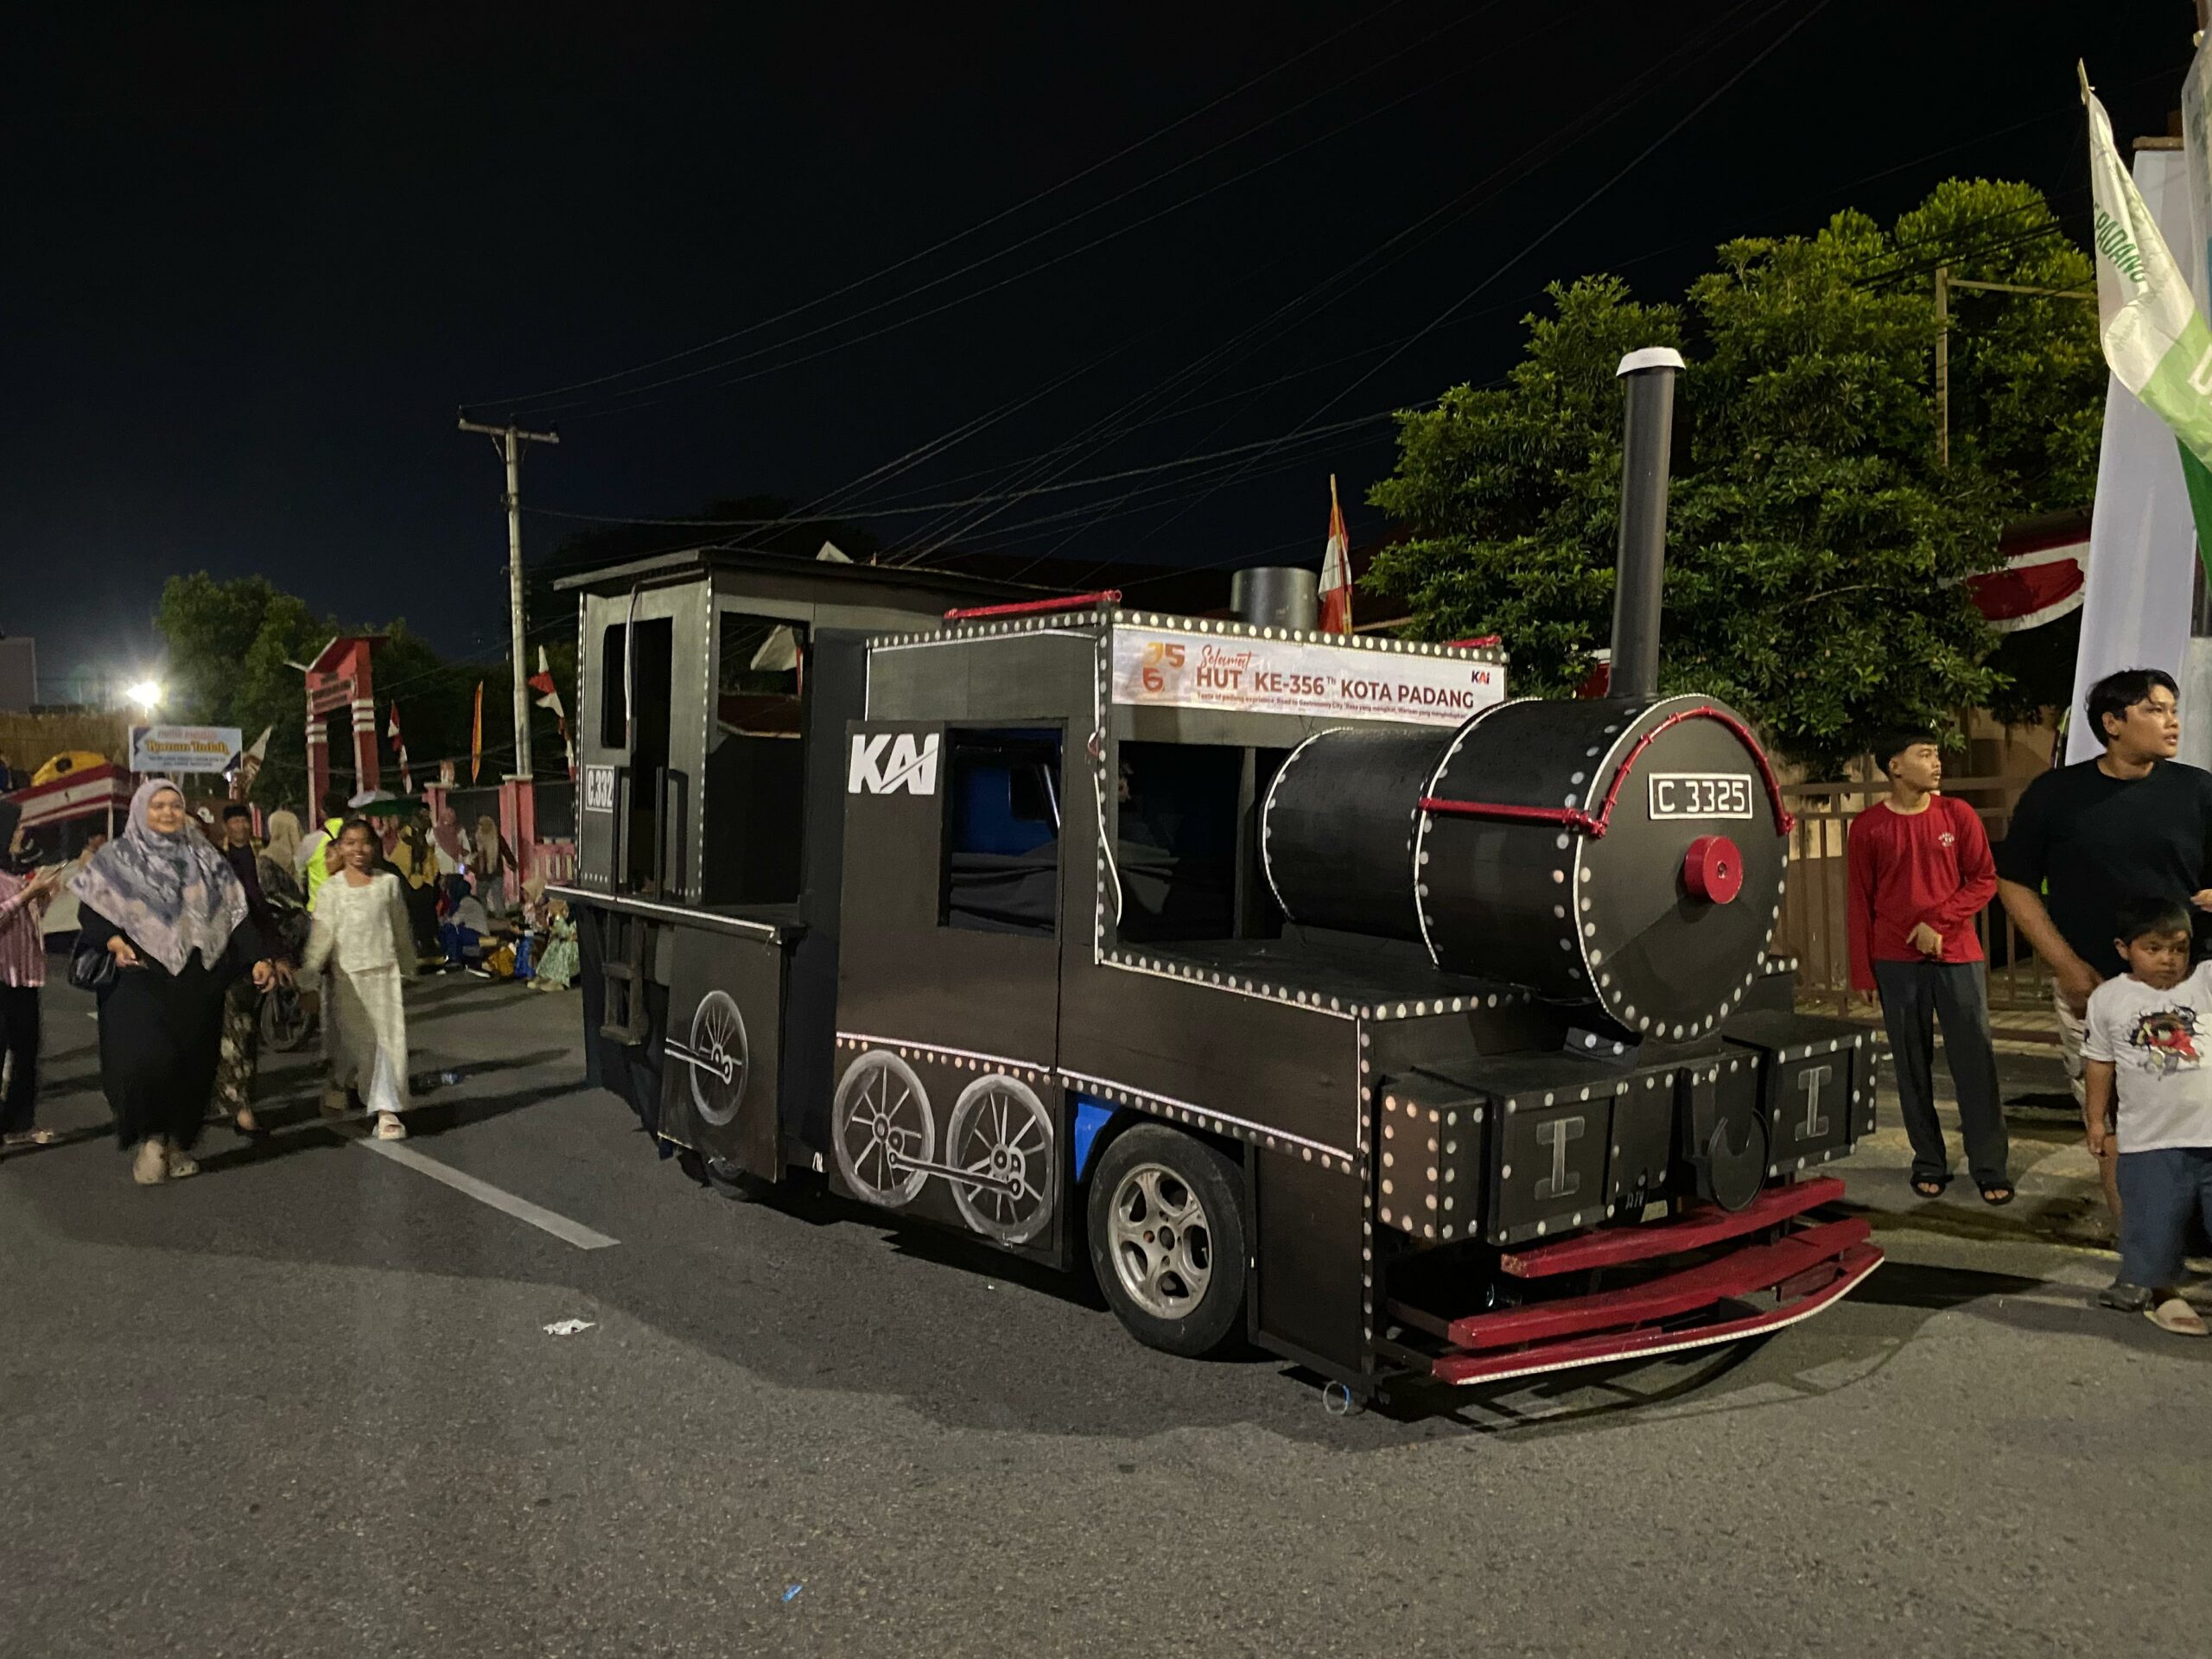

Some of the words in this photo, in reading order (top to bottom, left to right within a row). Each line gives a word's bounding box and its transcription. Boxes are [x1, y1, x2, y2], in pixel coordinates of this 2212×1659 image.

[1200, 644, 1258, 671] Selamat
[1197, 667, 1243, 690] HUT
[1255, 671, 1325, 696] KE-356
[1341, 678, 1392, 702] KOTA
[1398, 683, 1474, 709] PADANG
[848, 734, 940, 795] KAI
[1658, 780, 1675, 812] C
[1685, 780, 1745, 812] 3325
